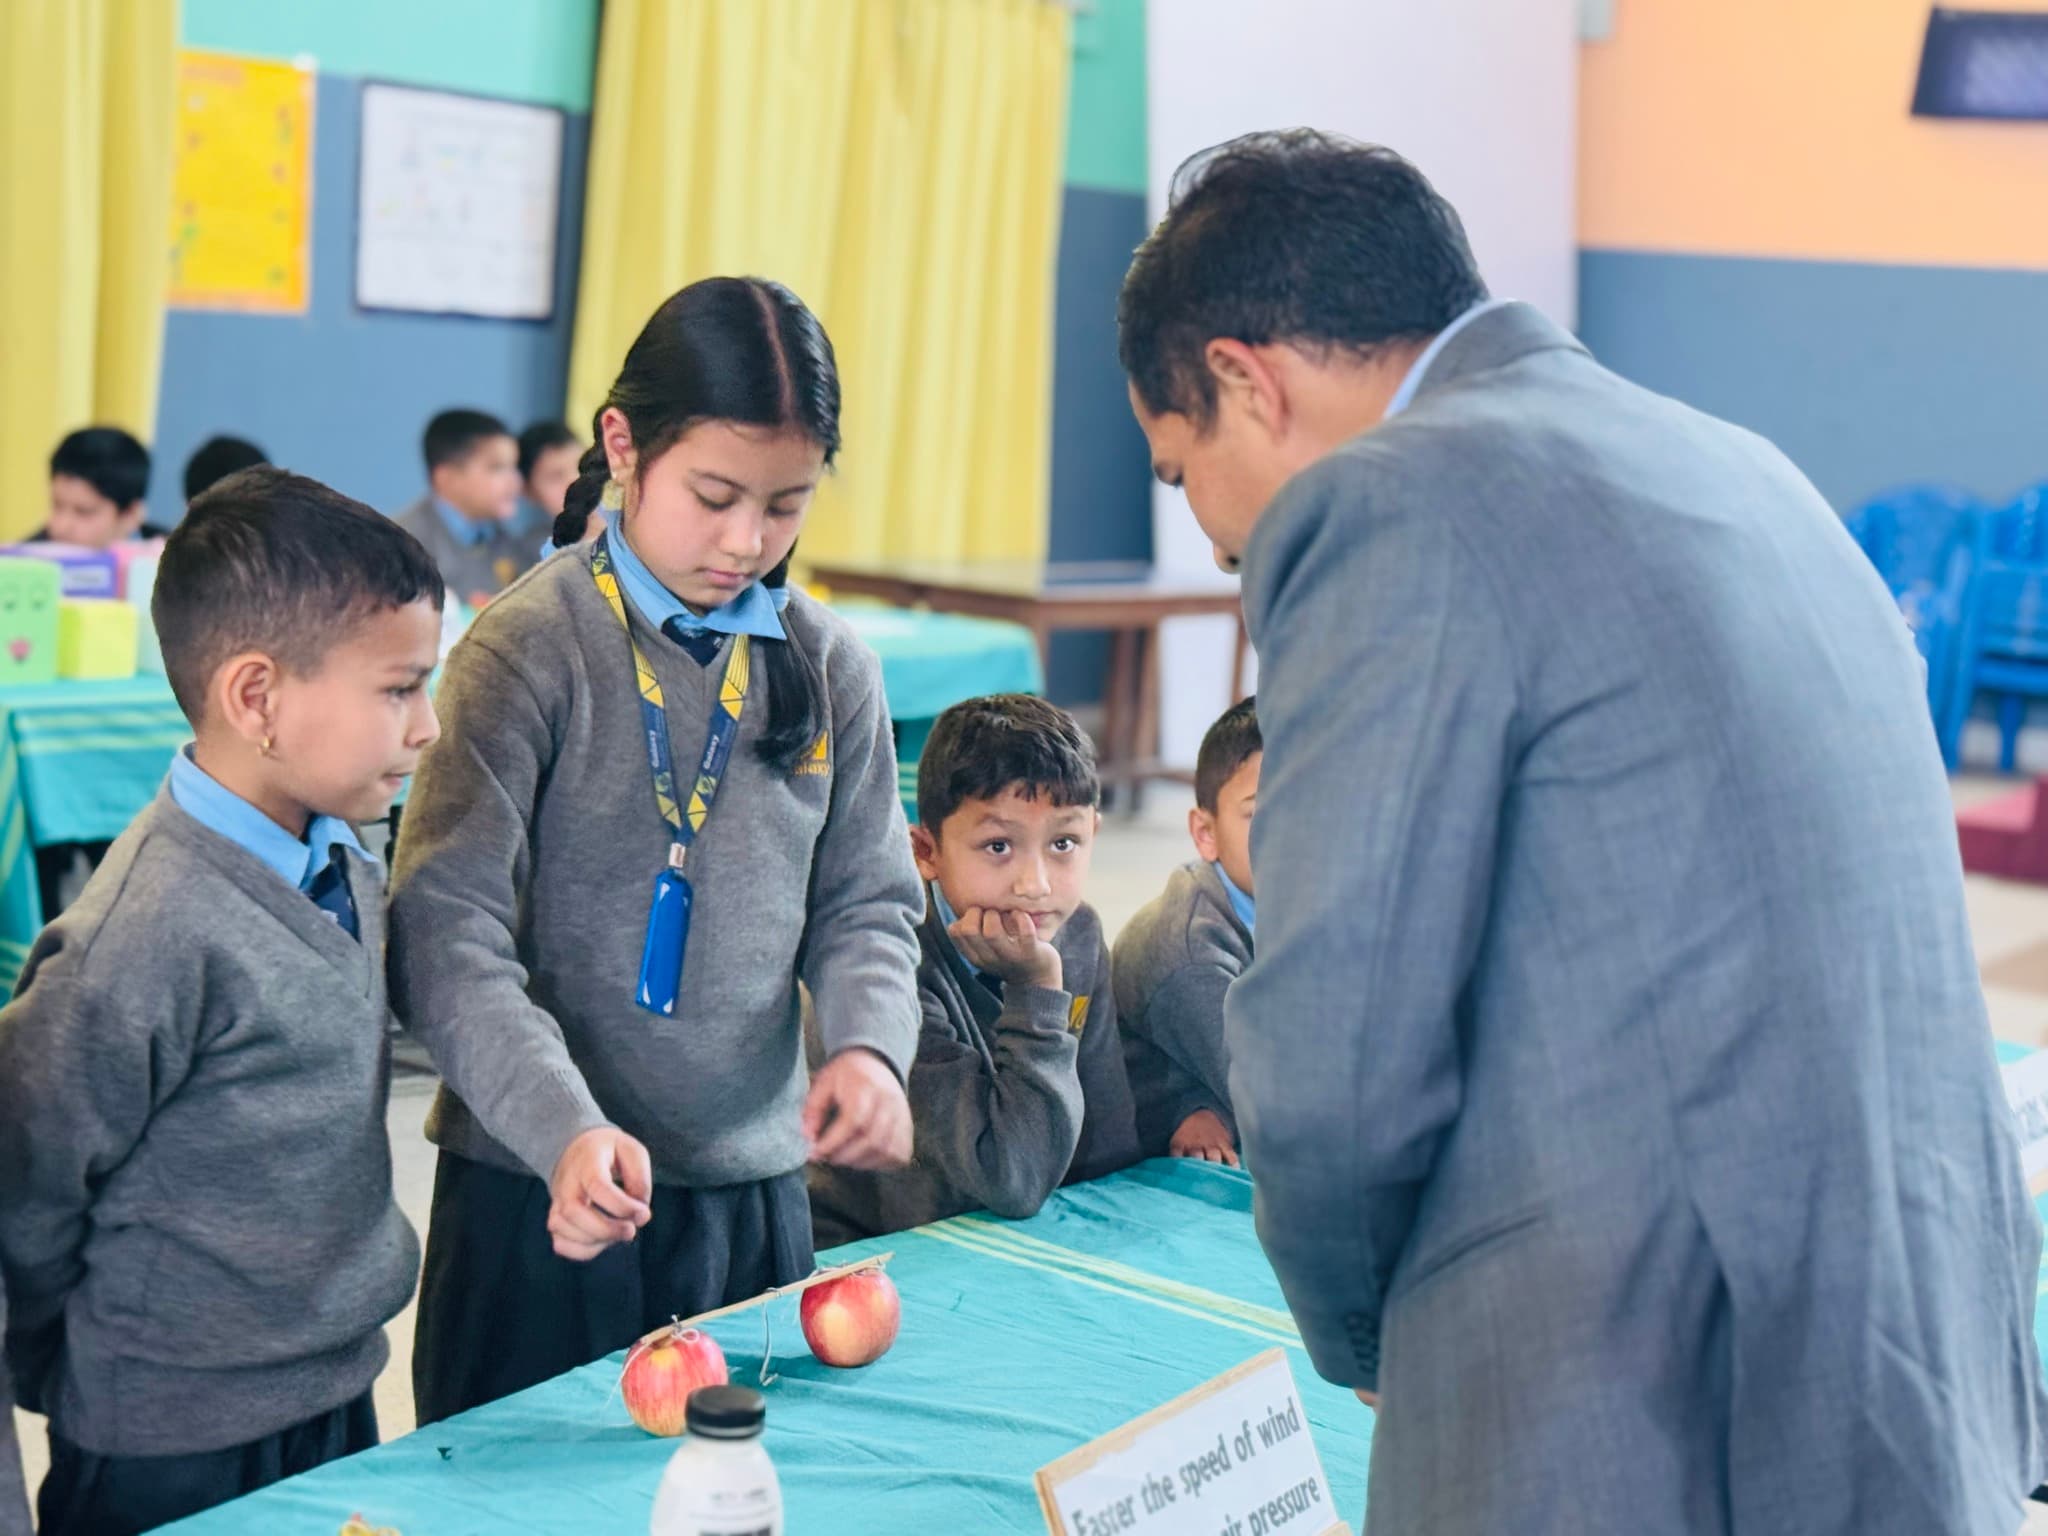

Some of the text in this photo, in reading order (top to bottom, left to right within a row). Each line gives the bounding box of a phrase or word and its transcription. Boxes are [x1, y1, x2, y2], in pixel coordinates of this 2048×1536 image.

[1141, 1471, 1176, 1515] the
[1178, 1433, 1232, 1498] speed
[1234, 1419, 1256, 1462] of
[1256, 1396, 1301, 1449] wind
[1247, 1476, 1321, 1536] pressure
